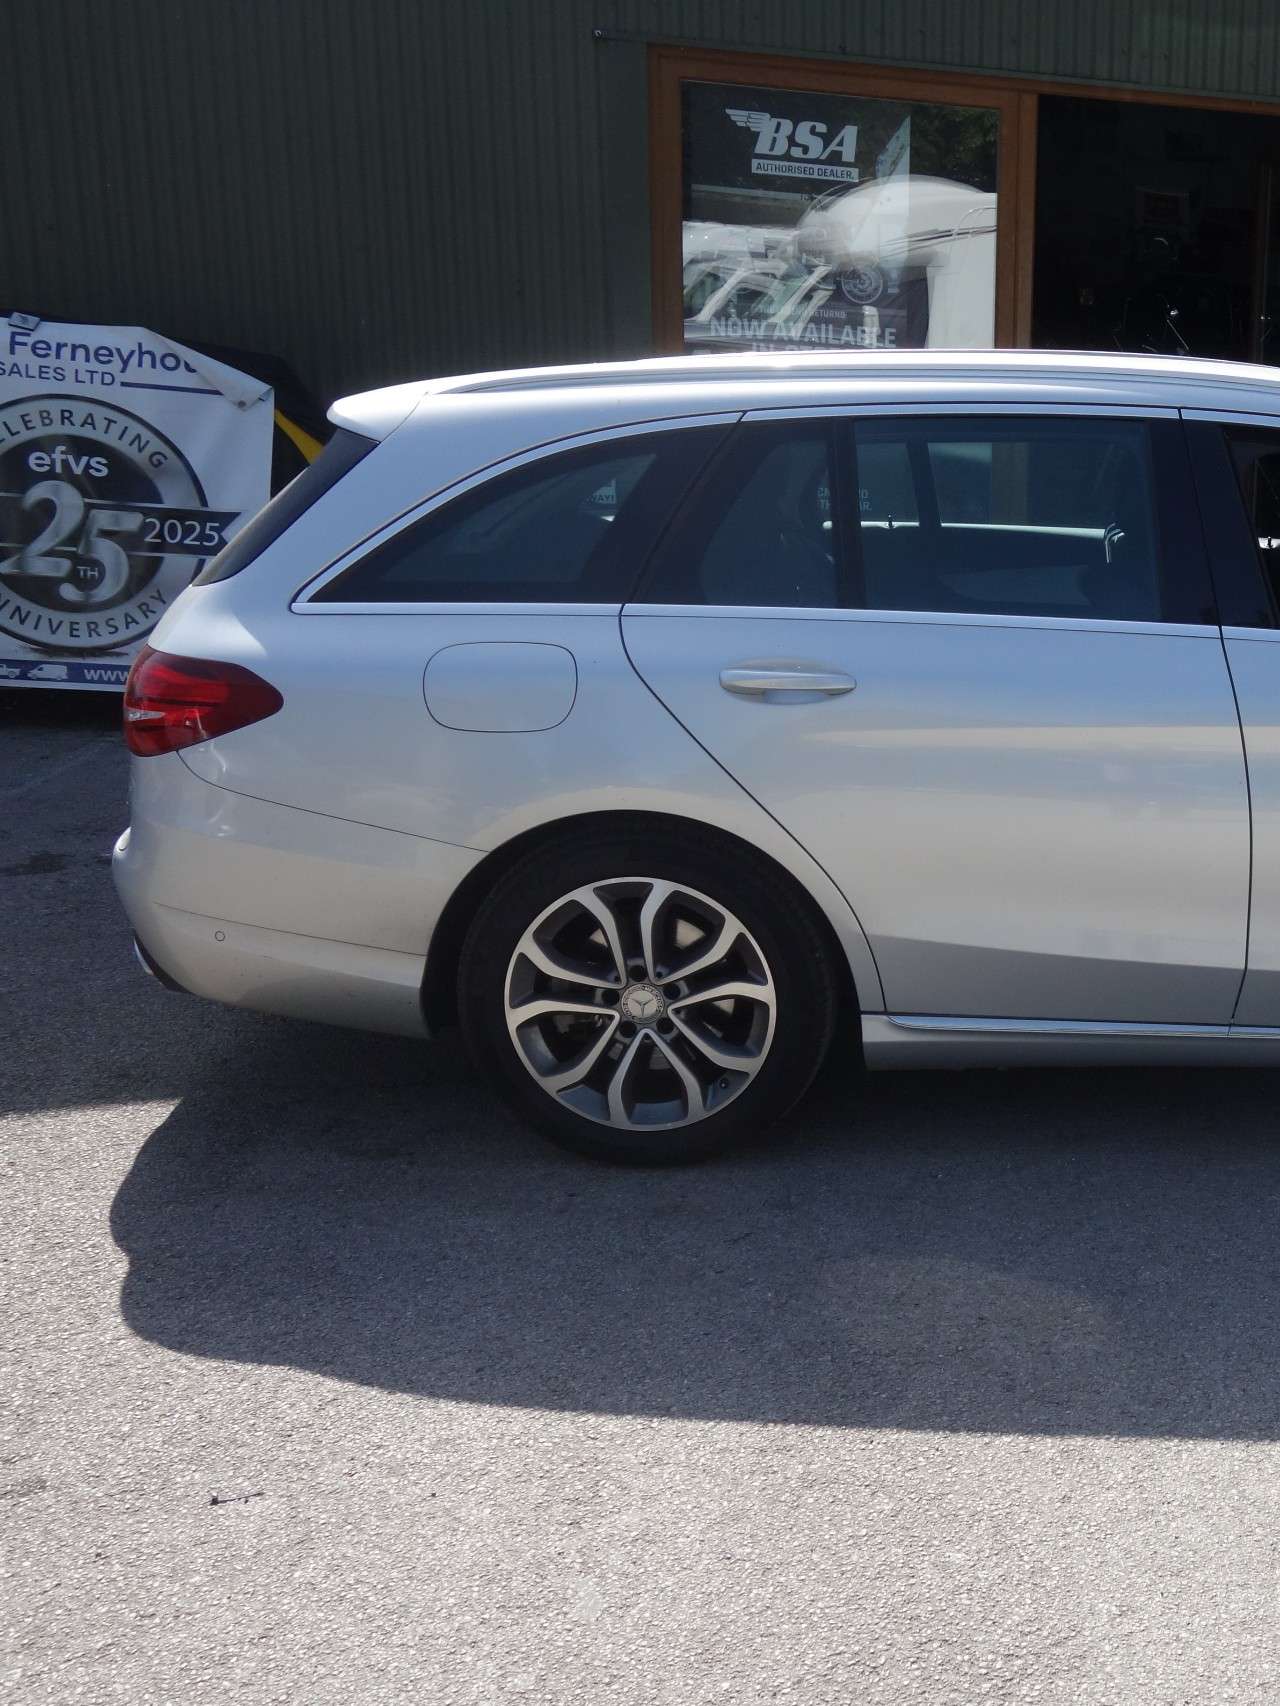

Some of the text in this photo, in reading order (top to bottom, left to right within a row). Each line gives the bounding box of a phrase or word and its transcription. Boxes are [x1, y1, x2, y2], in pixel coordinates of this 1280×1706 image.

[750, 113, 858, 162] BSA
[755, 162, 815, 176] AUTHORISED
[710, 316, 897, 348] NOW AVAILABLE
[74, 368, 116, 388] LTD
[0, 408, 169, 470] LEBRATING
[28, 446, 111, 478] efvs
[0, 480, 145, 603] 25
[143, 516, 221, 547] 2025
[77, 566, 99, 581] TH
